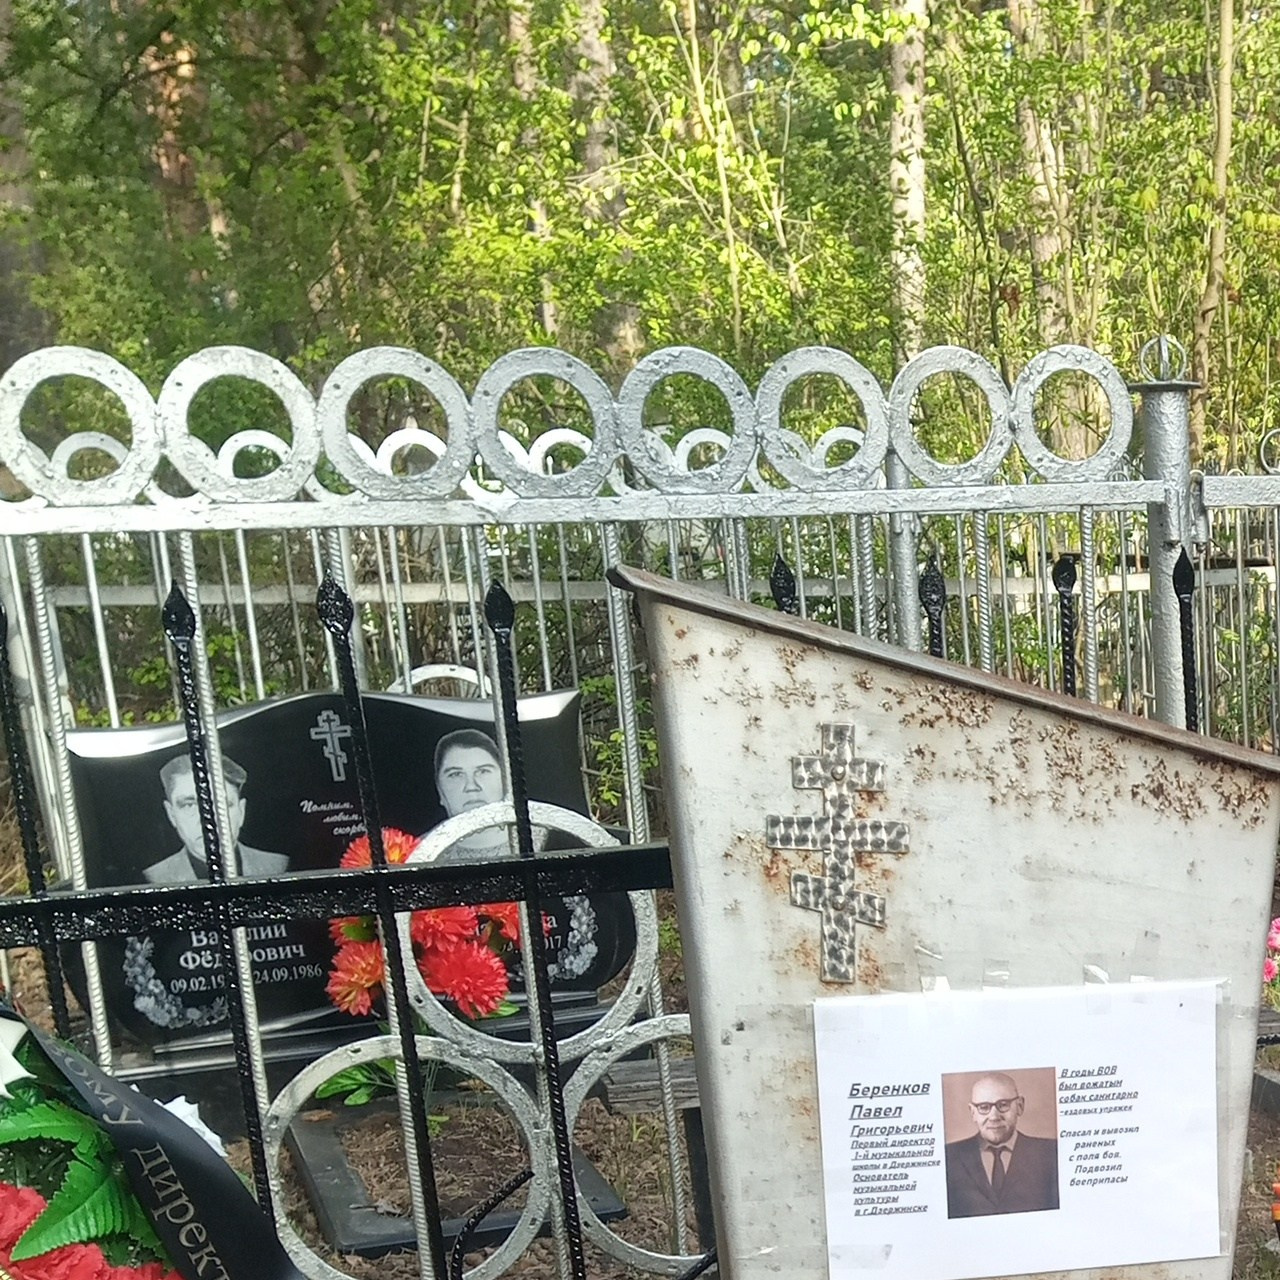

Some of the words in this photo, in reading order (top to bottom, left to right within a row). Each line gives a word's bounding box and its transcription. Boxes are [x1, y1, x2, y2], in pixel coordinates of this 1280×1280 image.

[190, 924, 288, 947] Валий
[1060, 1068, 1069, 1079] В
[1070, 1069, 1096, 1078] годы
[1097, 1065, 1118, 1077] ВОВ
[848, 1083, 930, 1099] Беренков
[1059, 1082, 1078, 1091] был
[1079, 1080, 1123, 1090] вожатым
[1059, 1094, 1087, 1104] собак
[1089, 1091, 1139, 1102] санитарно
[849, 1104, 903, 1120] Павел
[850, 1123, 933, 1138] Григорьевич
[1060, 1130, 1092, 1138] Спасал
[1101, 1126, 1139, 1136] вывозил
[851, 1138, 889, 1149] Первый
[890, 1138, 935, 1149] директор
[1074, 1139, 1116, 1151] раненых
[872, 1147, 934, 1159] музыкальной
[1076, 1152, 1100, 1161] поля
[890, 1160, 940, 1170] Дзержинске
[1074, 1164, 1123, 1174] Подвозил
[852, 1173, 909, 1182] Основатель
[1069, 1176, 1129, 1187] боеприпасы
[853, 1181, 917, 1194] музыкальной
[854, 1196, 899, 1206] культуры
